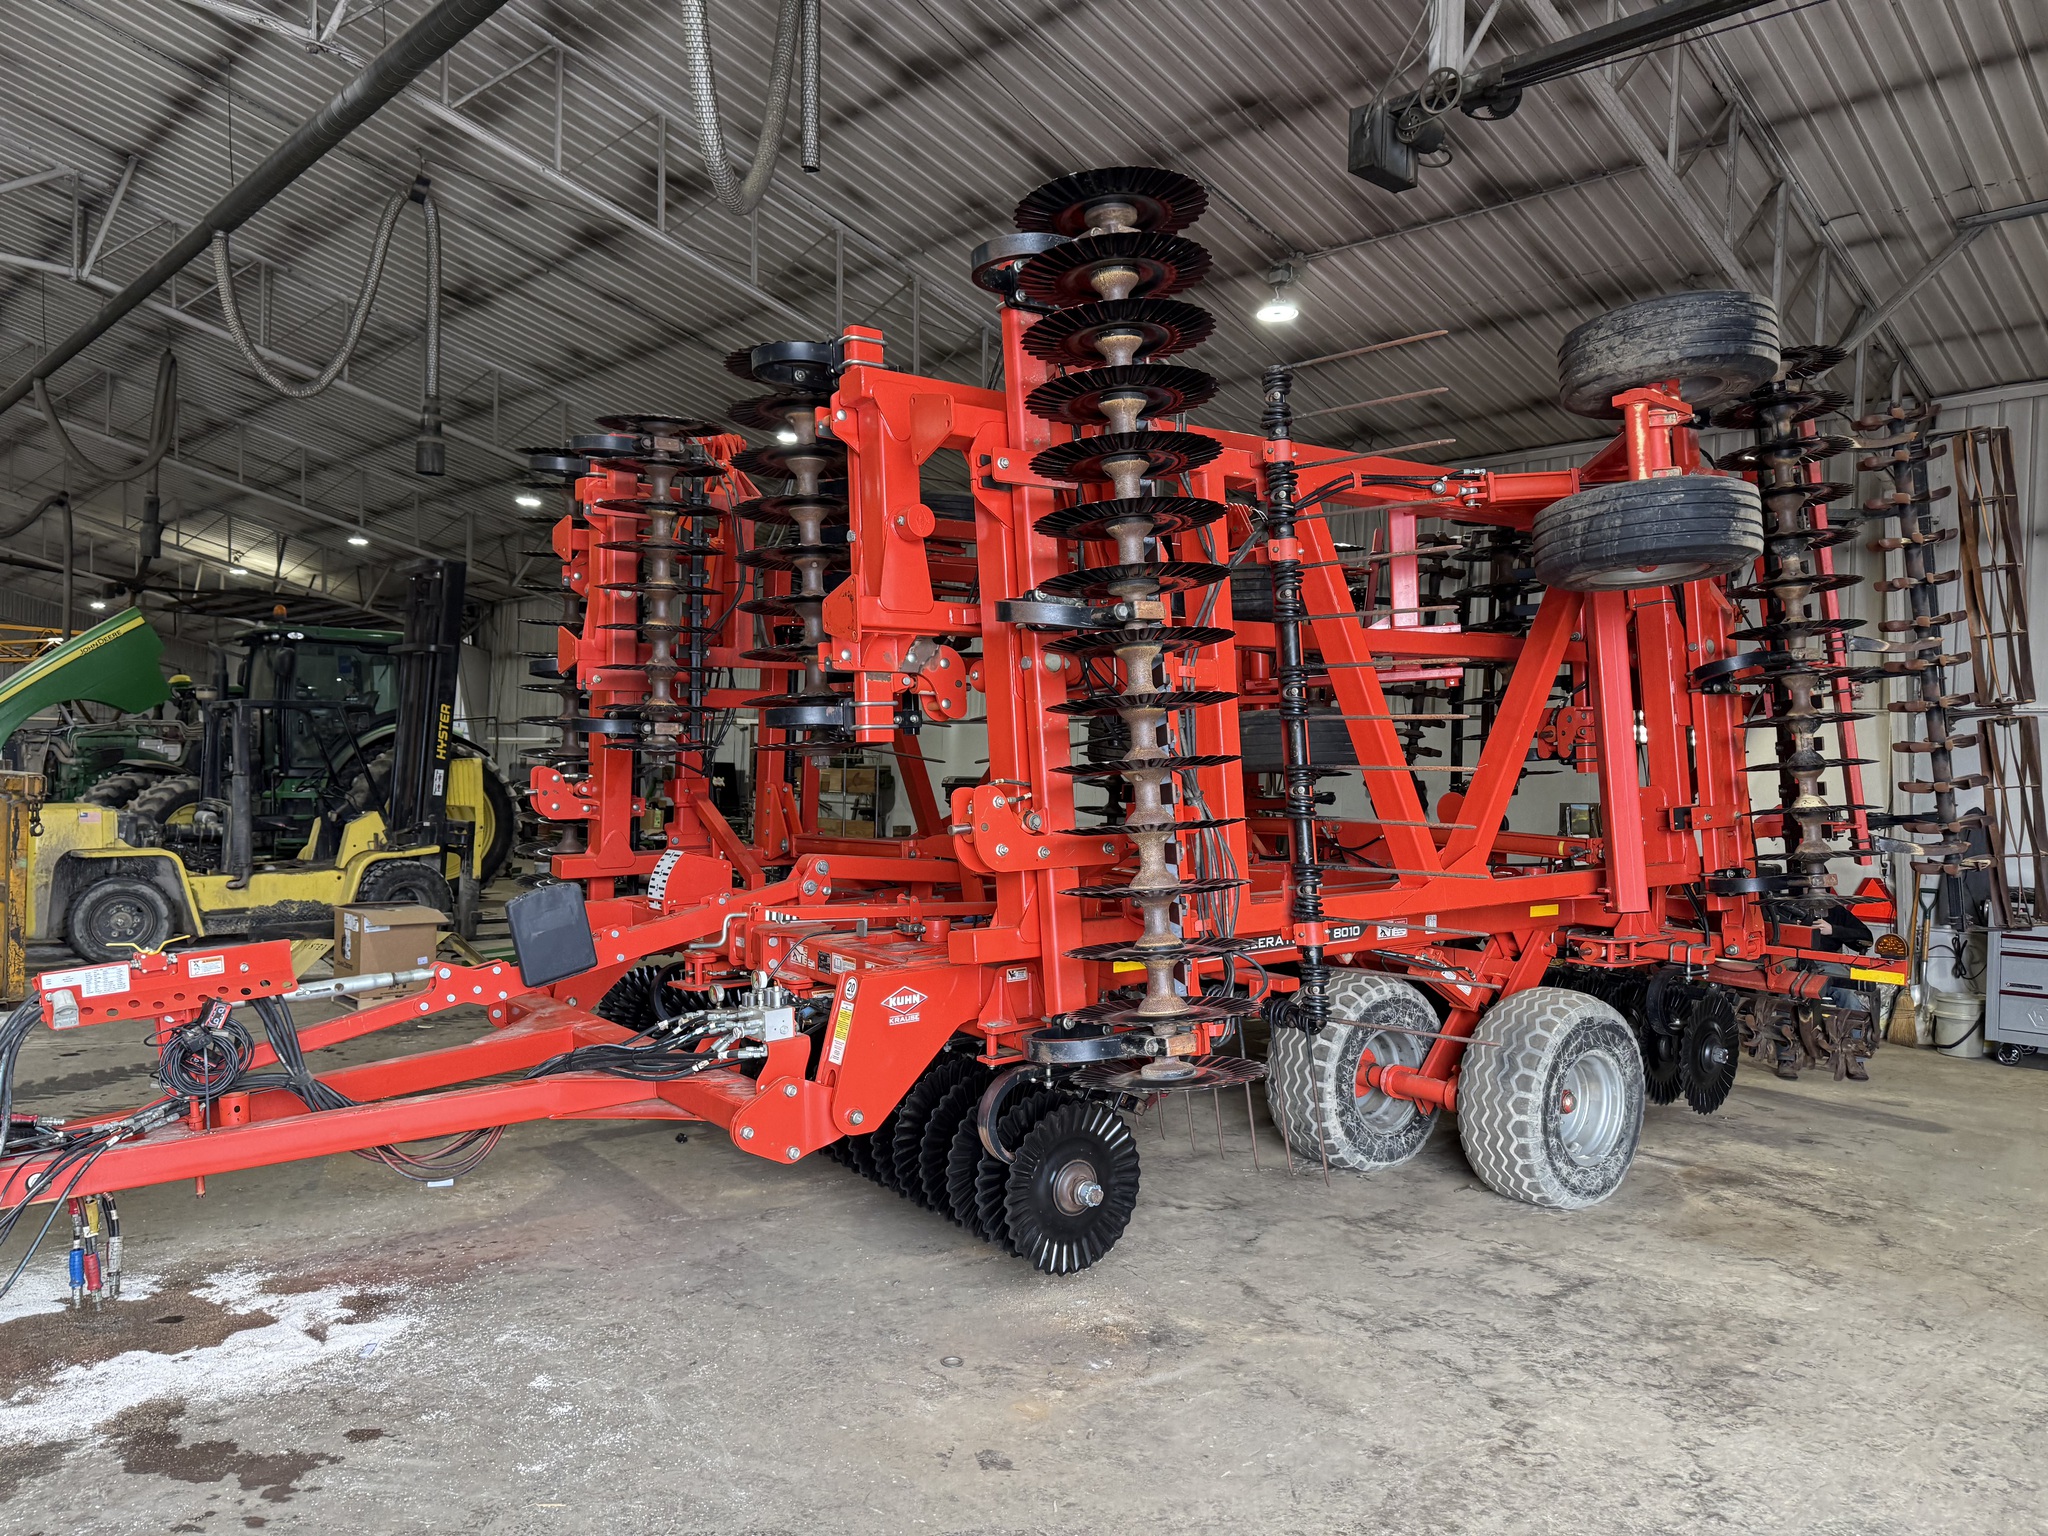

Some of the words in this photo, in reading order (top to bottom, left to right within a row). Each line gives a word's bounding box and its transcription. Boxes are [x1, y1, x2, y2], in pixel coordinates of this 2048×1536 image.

[80, 641, 99, 655] JOHN
[98, 629, 122, 645] DEERE
[436, 703, 451, 760] HYSTER
[1333, 925, 1361, 939] 8010
[846, 981, 856, 993] 20
[889, 994, 920, 1007] KUHN
[889, 1013, 920, 1024] KRAUSE
